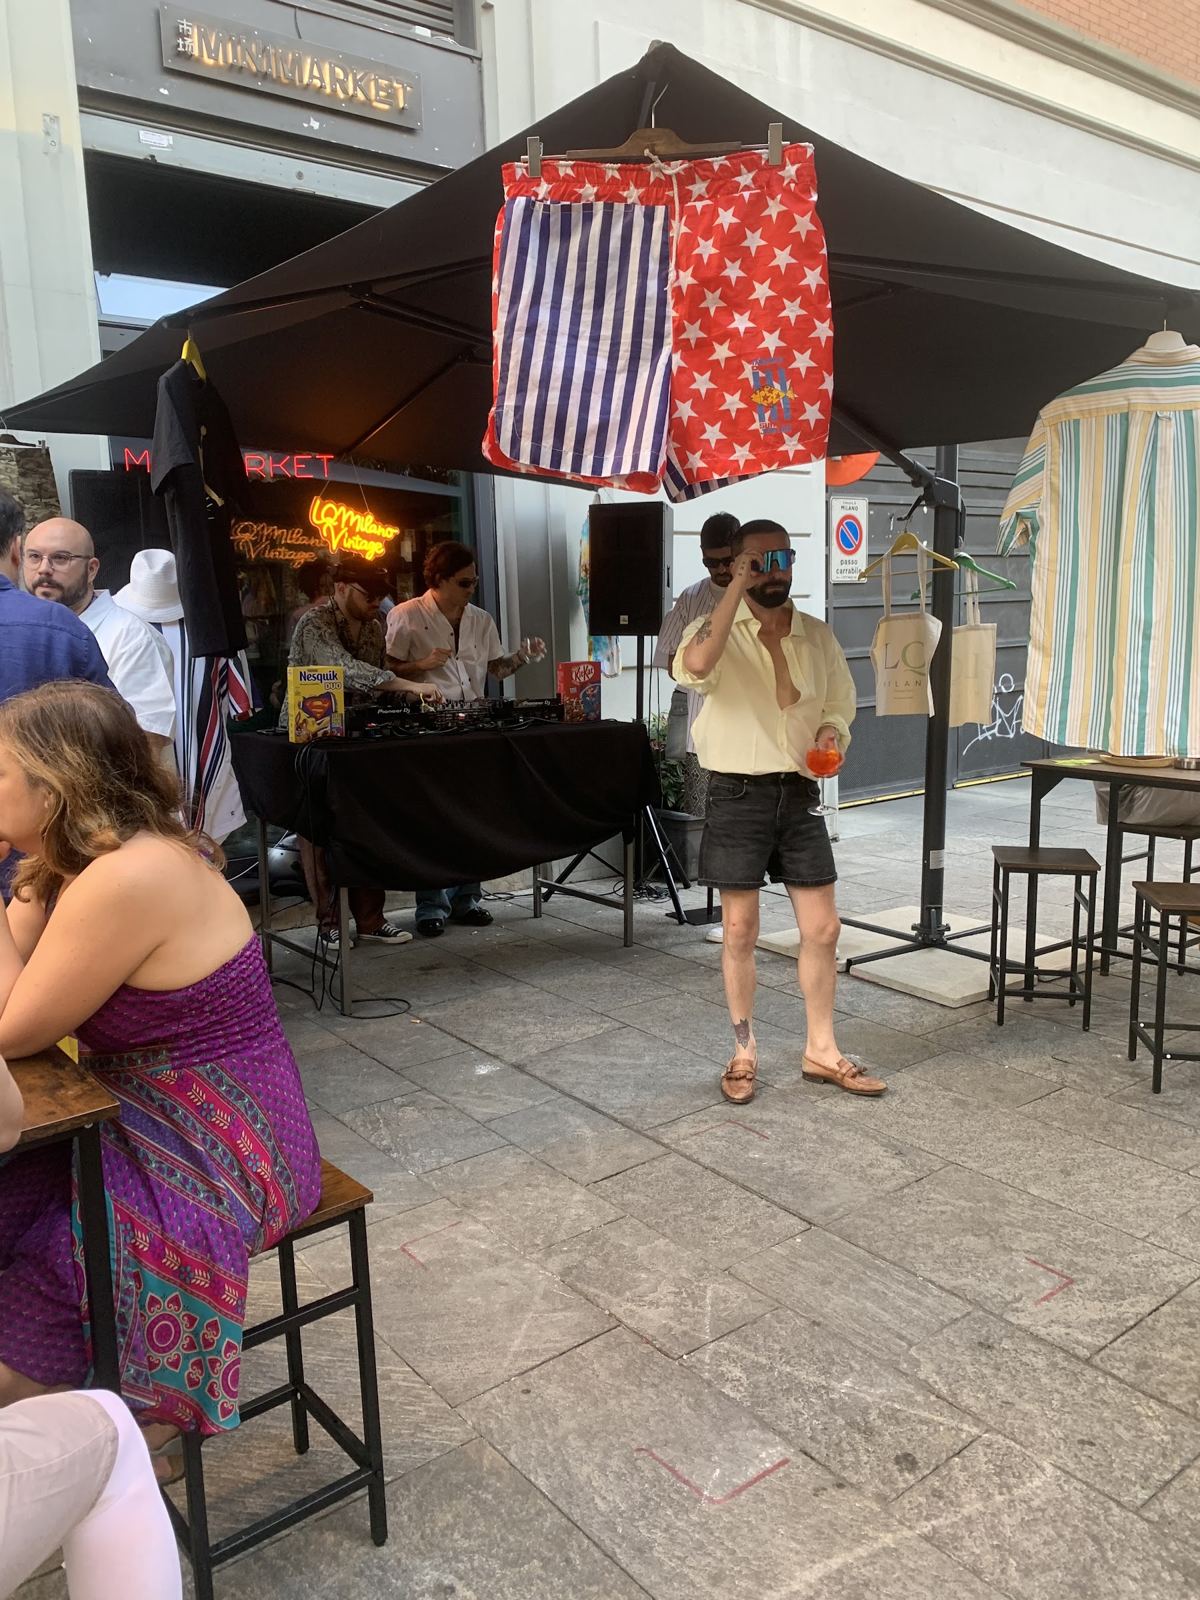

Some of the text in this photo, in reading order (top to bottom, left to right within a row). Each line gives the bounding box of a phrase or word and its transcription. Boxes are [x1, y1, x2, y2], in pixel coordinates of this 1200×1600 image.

[192, 23, 414, 111] MINIMARKET
[124, 447, 334, 479] MRKET
[323, 523, 385, 561] Vintage
[299, 670, 338, 684] Nesquik
[325, 682, 341, 690] DUO
